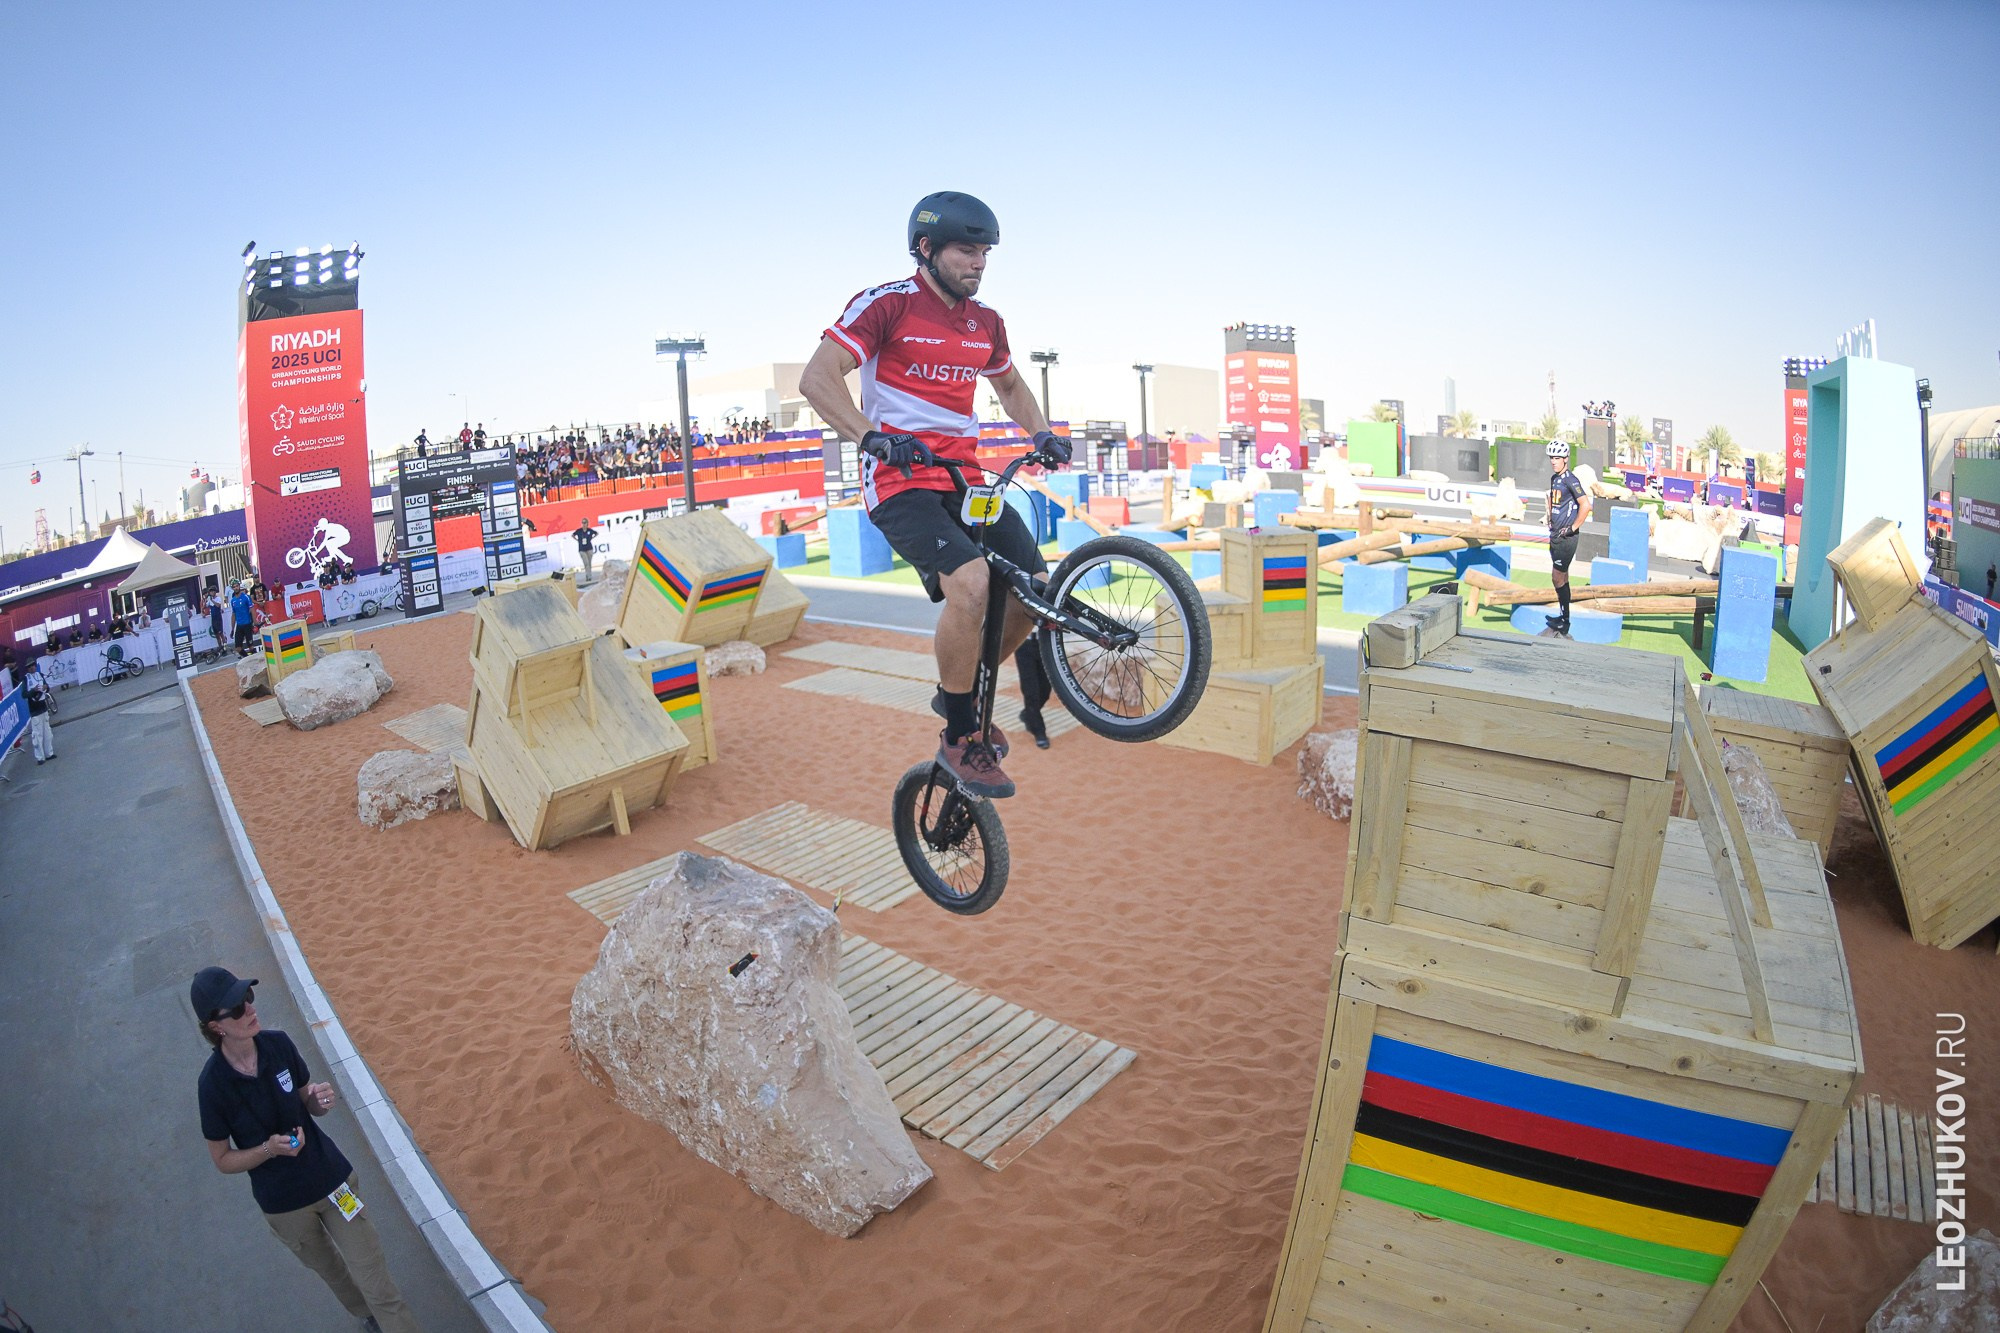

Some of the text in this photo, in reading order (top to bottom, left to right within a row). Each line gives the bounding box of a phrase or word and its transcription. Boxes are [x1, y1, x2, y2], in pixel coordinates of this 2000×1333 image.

[271, 327, 341, 353] RIYADH
[961, 340, 991, 349] CHAOYANG
[271, 348, 342, 370] 2025 UCI
[271, 364, 342, 379] URBAN CYCLING WORLD
[271, 372, 342, 388] CHAMPIONSHIPS
[326, 402, 344, 413] وزارة
[1792, 397, 1808, 408] RIYA
[298, 415, 321, 424] Ministry
[296, 438, 317, 448] SAUDI
[317, 434, 345, 445] CYCLING
[408, 461, 426, 471] UCI
[284, 475, 299, 484] UCI
[447, 474, 473, 486] FINISH
[1428, 487, 1461, 503] UCI
[410, 496, 427, 506] UCI
[1960, 501, 1971, 520] UCI
[454, 570, 479, 579] CYCLING
[505, 566, 521, 575] UCI
[418, 583, 435, 593] UCI
[169, 604, 186, 614] START
[175, 612, 183, 627] 1
